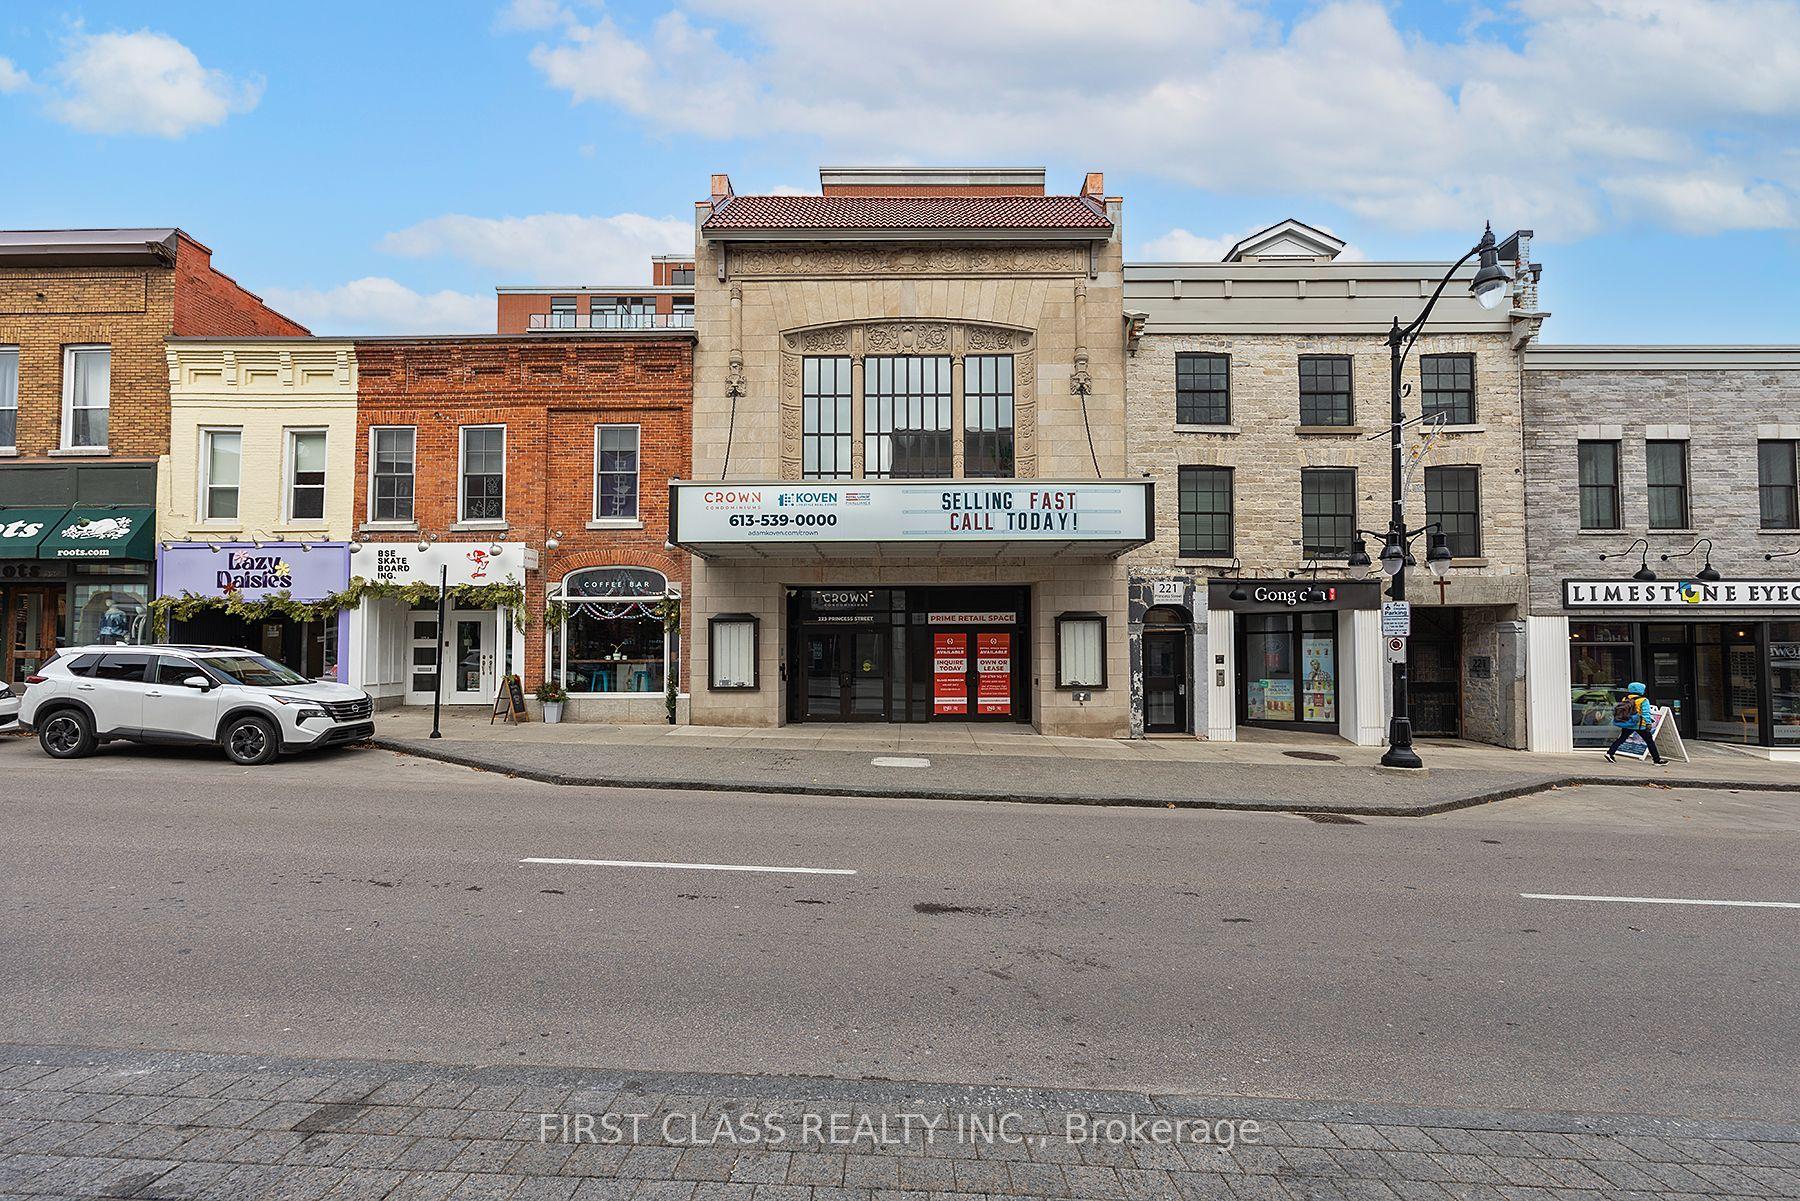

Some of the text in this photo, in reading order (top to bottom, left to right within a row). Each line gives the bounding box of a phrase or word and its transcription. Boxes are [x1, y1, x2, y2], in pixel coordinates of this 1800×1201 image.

[704, 492, 761, 503] CROWN
[796, 492, 837, 503] KOVEN
[941, 492, 1076, 510] SELLING FAST
[729, 514, 837, 527] 613-539-0000
[950, 512, 1078, 531] CALL TODAY!
[0, 520, 44, 538] ts
[747, 529, 819, 537] adamkoven.com/crown
[57, 548, 110, 557] roots.com
[377, 549, 396, 558] BSE
[228, 552, 282, 575] Lazy
[377, 557, 407, 565] SKATE
[377, 564, 410, 572] BOARD
[216, 570, 293, 589] Daisies
[377, 572, 397, 580] ING.
[1159, 583, 1178, 593] 221
[823, 593, 869, 603] CROWN
[1254, 586, 1297, 606] Gong
[988, 614, 1014, 622] SPACE
